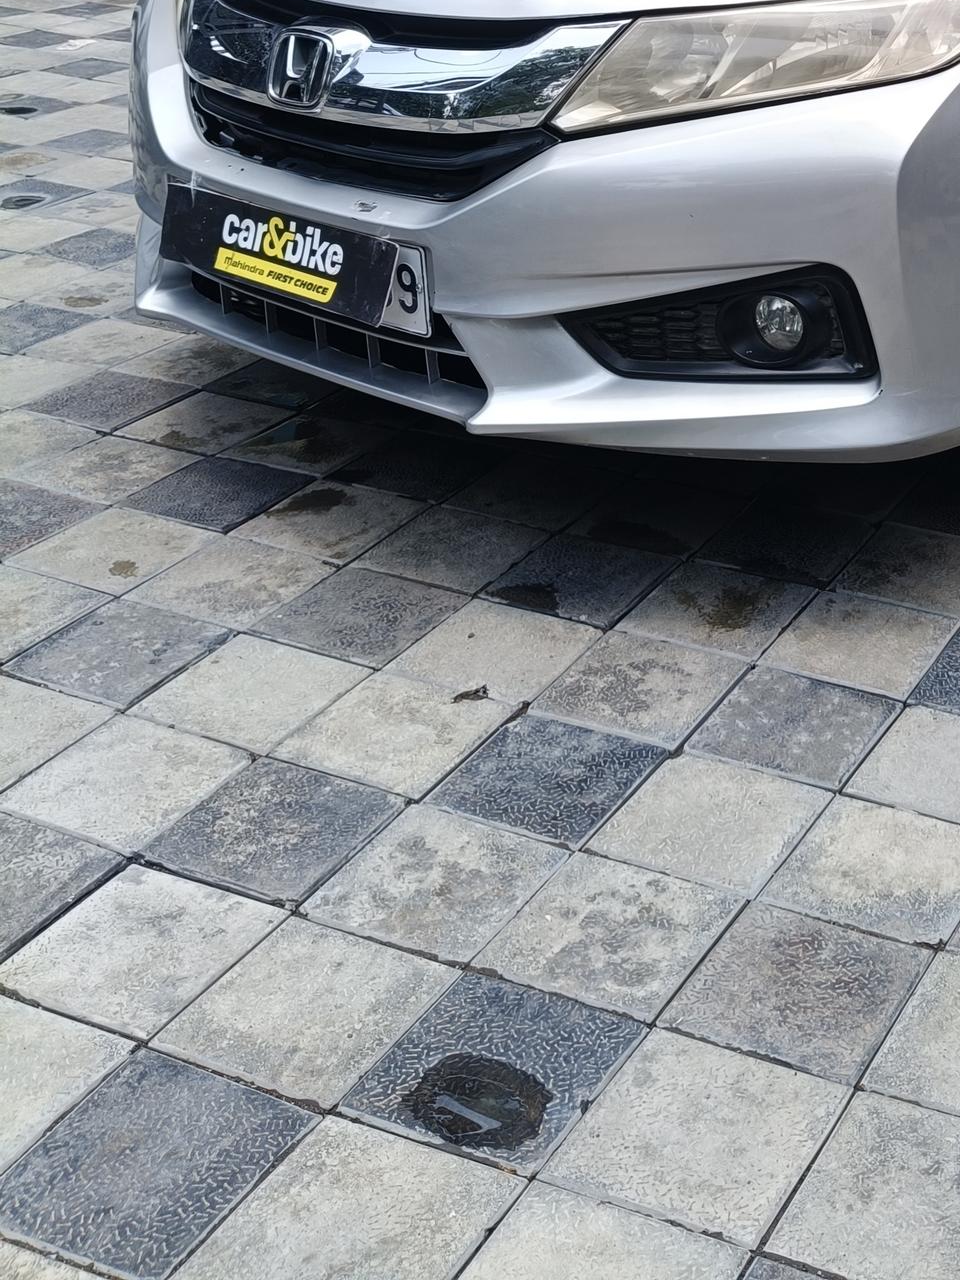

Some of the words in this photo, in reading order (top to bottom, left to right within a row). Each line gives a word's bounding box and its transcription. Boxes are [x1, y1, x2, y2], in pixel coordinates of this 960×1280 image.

[222, 213, 344, 276] car&bike
[266, 270, 295, 285] FIRST
[294, 279, 329, 296] CHOICE
